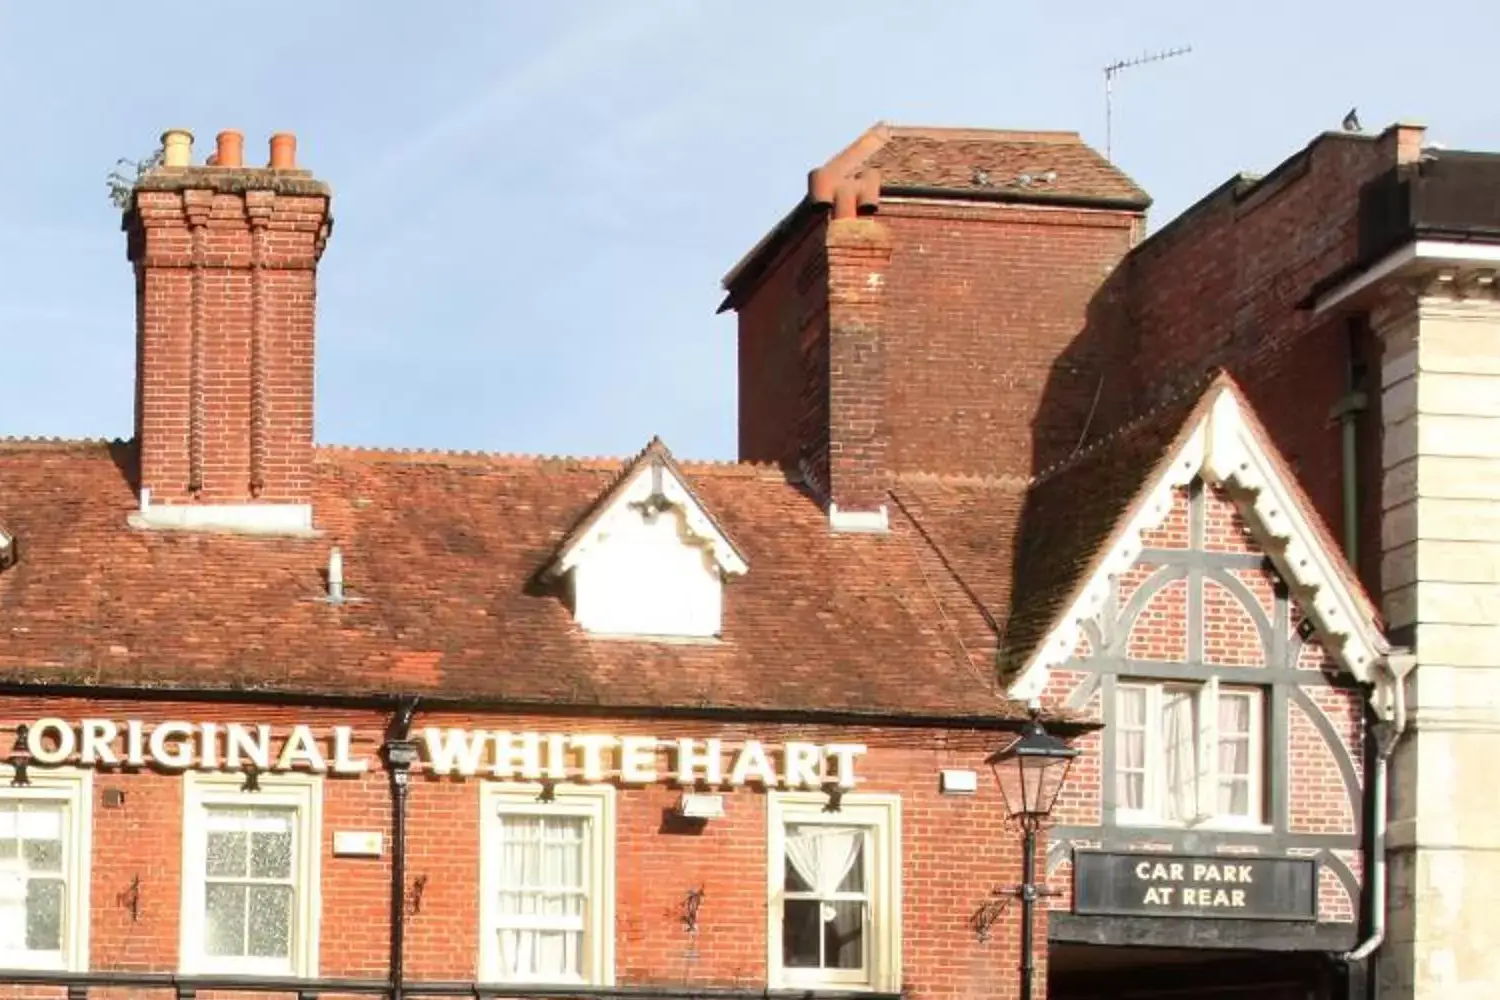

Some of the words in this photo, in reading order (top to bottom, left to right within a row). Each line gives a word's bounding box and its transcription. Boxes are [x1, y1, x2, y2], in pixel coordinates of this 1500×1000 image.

[27, 717, 368, 772] ORIGINAL
[424, 727, 658, 783] WHITE
[678, 739, 868, 788] HART
[1135, 861, 1184, 881] CAR
[1193, 864, 1253, 883] PARK
[1142, 887, 1173, 905] AT
[1183, 888, 1246, 907] REAR
